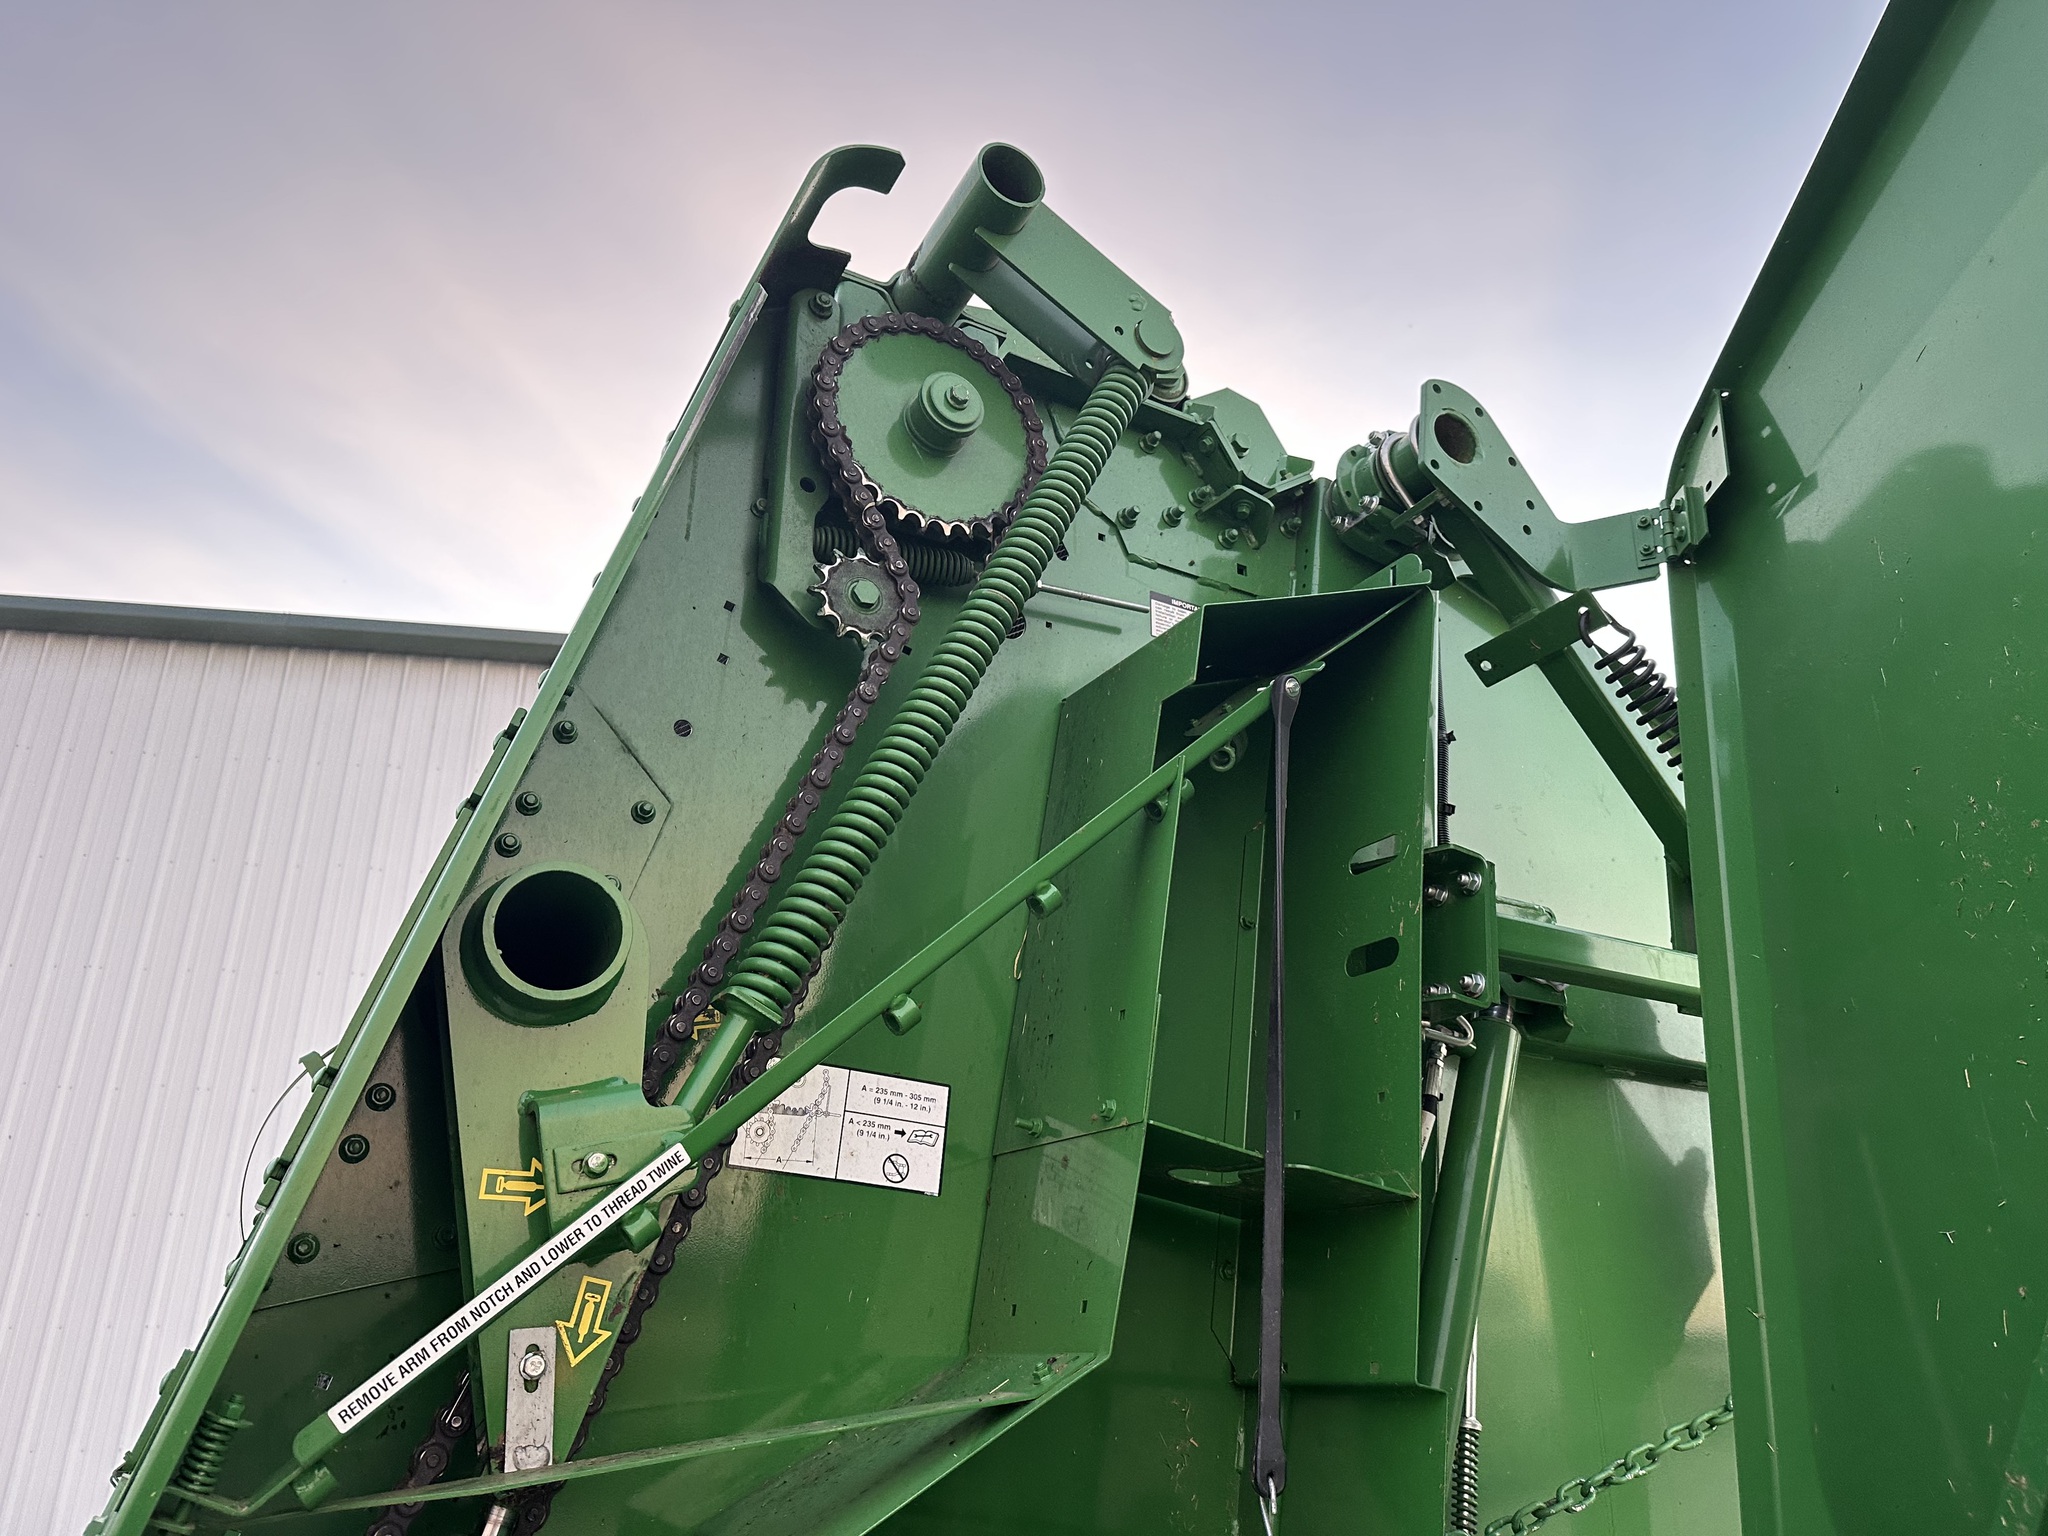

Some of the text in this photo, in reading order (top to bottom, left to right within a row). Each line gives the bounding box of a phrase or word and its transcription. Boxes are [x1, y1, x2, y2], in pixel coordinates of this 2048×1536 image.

[1171, 599, 1200, 611] IMPORTA
[861, 1084, 867, 1092] A
[875, 1086, 888, 1095] 235
[889, 1090, 903, 1098] mm
[909, 1092, 921, 1101] 305
[923, 1095, 937, 1104] mm
[873, 1096, 881, 1105] (9
[883, 1097, 893, 1106] 1/4
[894, 1100, 904, 1108] in.
[910, 1103, 918, 1111] 12
[919, 1104, 931, 1114] in.)
[848, 1117, 854, 1125] A
[862, 1119, 876, 1128] 235
[877, 1123, 891, 1131] mm
[856, 1129, 890, 1141] (9 1/4 in.)
[776, 1155, 782, 1163] A
[337, 1150, 684, 1424] REMOVE ARM FROM NOTCH AND LOWER TO THREAD TWINE
